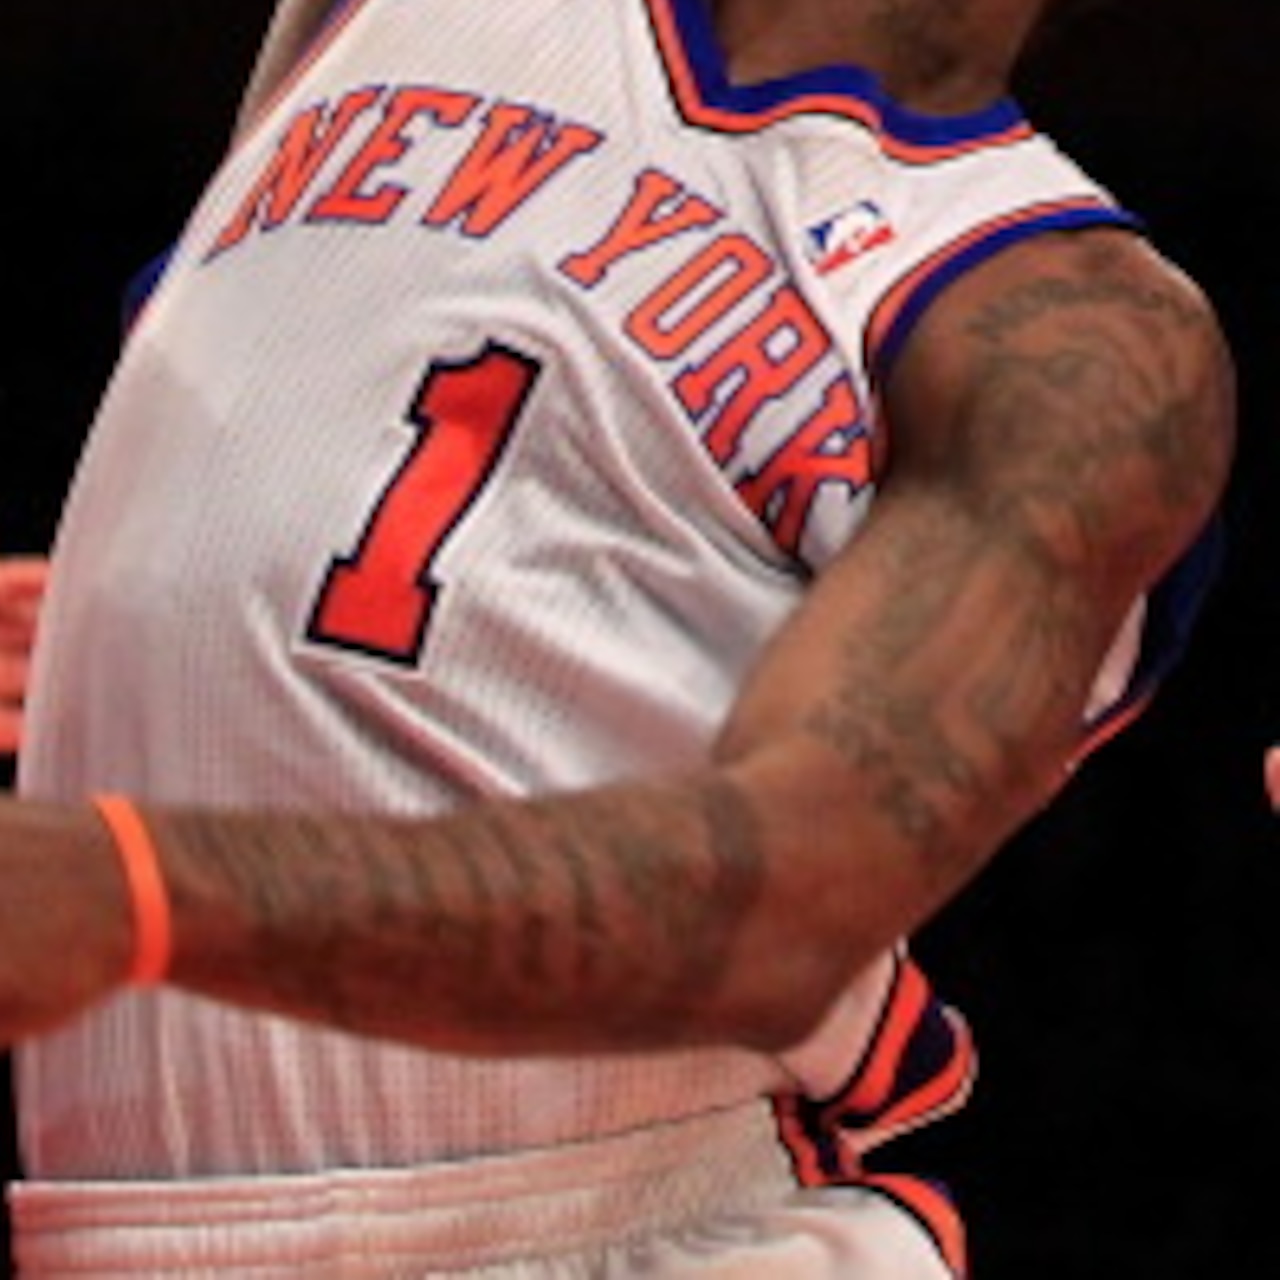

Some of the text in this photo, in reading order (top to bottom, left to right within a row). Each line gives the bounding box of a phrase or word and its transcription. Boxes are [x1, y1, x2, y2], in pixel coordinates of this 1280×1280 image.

[199, 84, 877, 572] NEW YORK
[302, 338, 544, 670] 1
